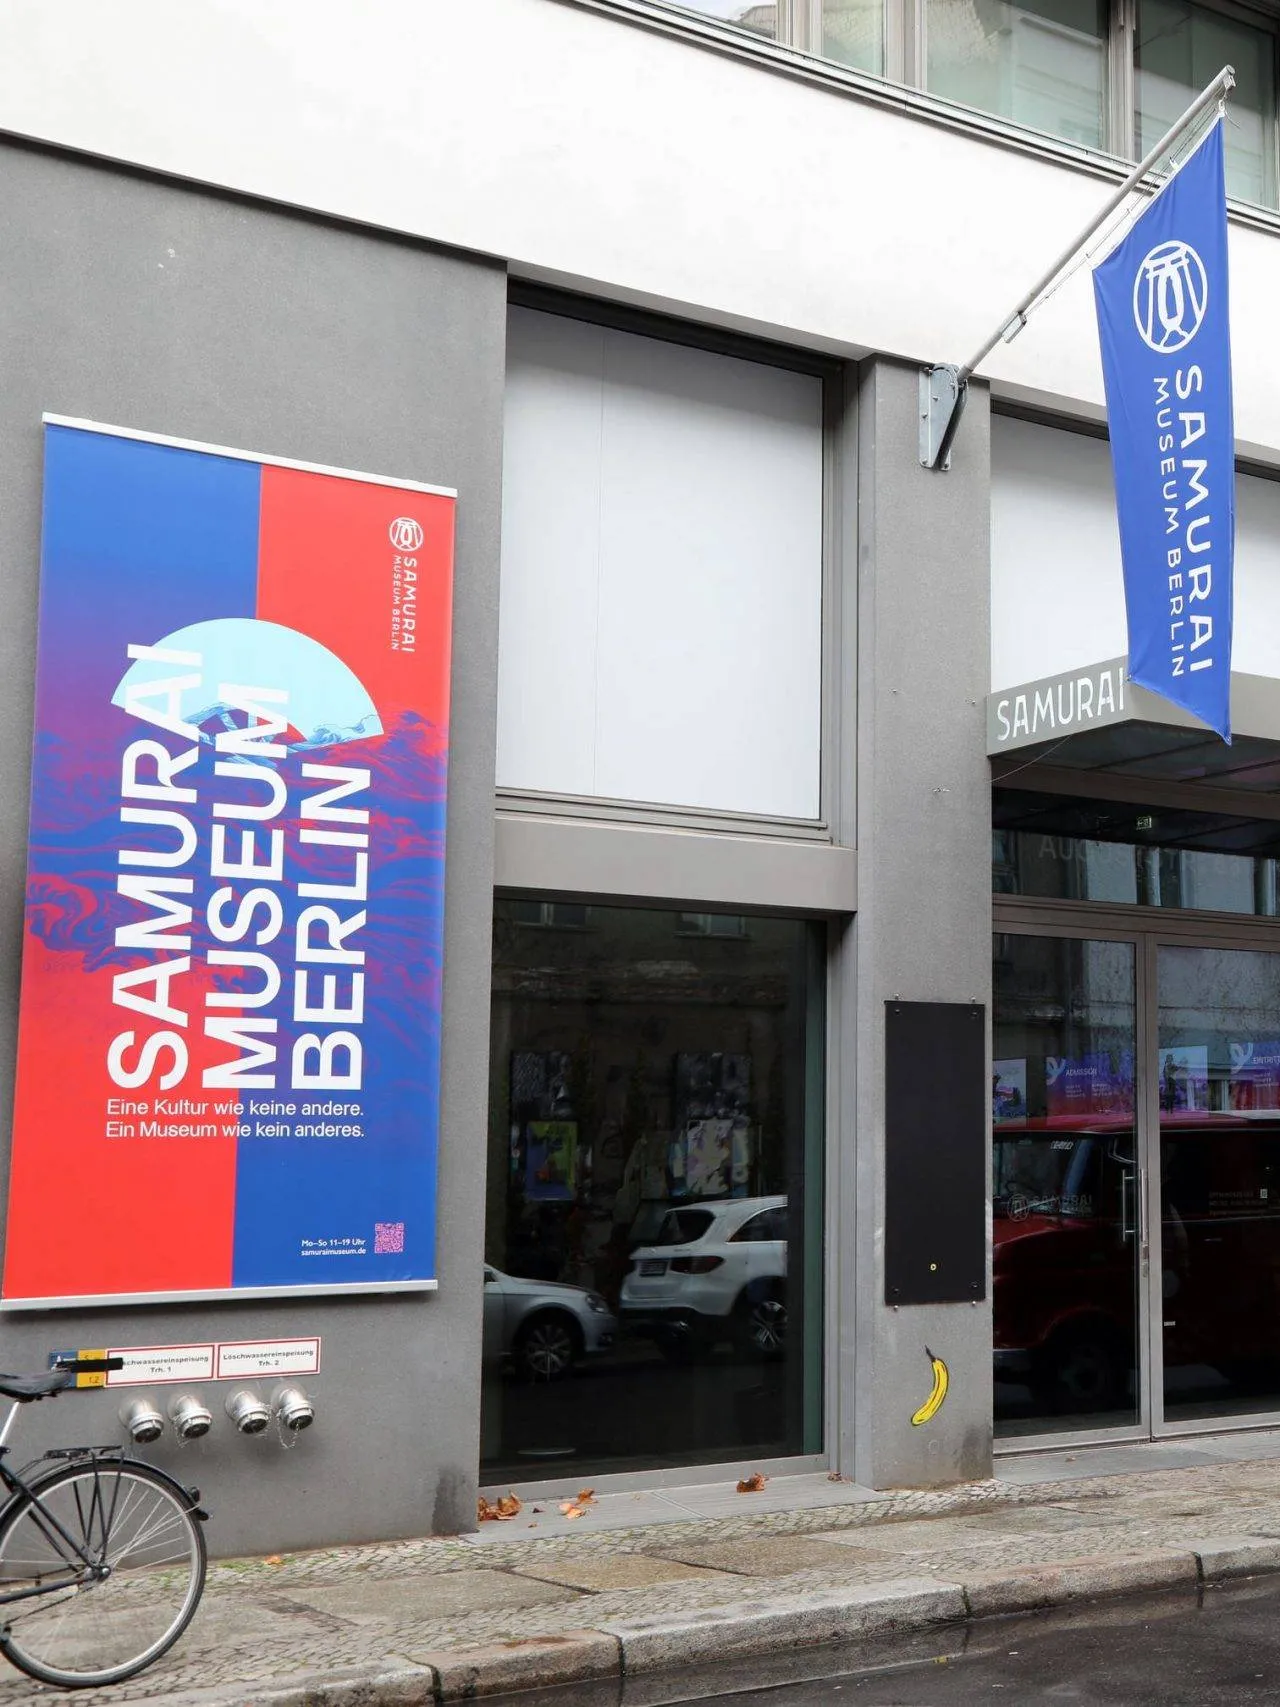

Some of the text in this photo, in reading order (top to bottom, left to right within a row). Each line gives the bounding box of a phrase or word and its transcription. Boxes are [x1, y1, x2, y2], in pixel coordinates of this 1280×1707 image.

[1153, 376, 1185, 678] MUSEUM BERLIN
[1175, 364, 1213, 673] SAMURAI
[390, 554, 402, 651] MUSEUM BERLIN
[402, 556, 418, 653] SAMURAI
[997, 668, 1125, 742] SAMURAI
[107, 644, 203, 1090] SAMURAI
[202, 683, 290, 1089] MUSEUM
[291, 763, 371, 1090] BERLIN
[106, 1121, 365, 1138] Ein Museum wie kein anderes.
[107, 1099, 364, 1116] Eine Kultur wie keine andere.
[301, 1247, 367, 1256] samuraimuseum.de
[351, 1237, 366, 1246] Uhr
